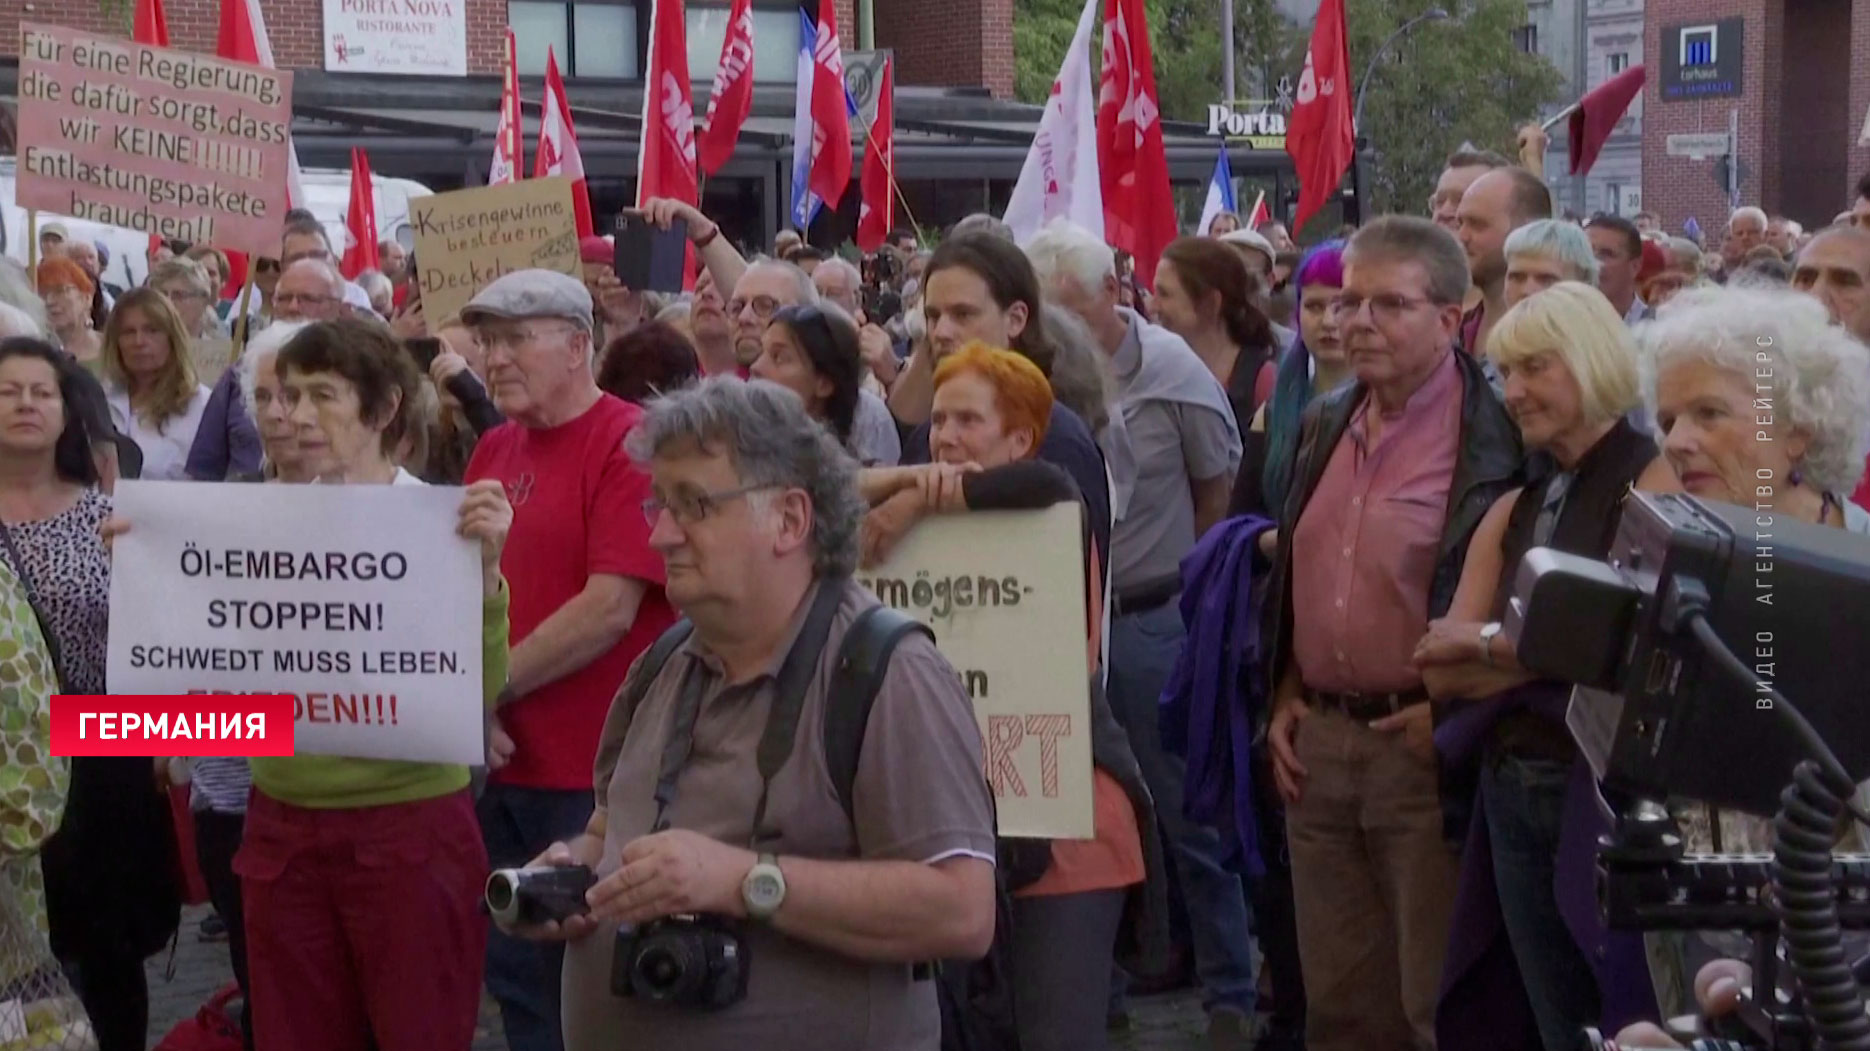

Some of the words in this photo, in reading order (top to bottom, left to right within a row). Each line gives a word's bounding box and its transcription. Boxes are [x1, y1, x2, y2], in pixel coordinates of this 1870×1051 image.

[356, 19, 436, 33] RISTORANTE
[22, 31, 63, 63] Für
[72, 41, 130, 74] eine
[139, 50, 281, 104] Regierung,
[22, 70, 61, 101] die
[71, 81, 142, 117] dafür
[60, 117, 100, 143] wir
[1206, 104, 1286, 135] Porta
[26, 146, 266, 218] Entlastungspakete
[71, 191, 214, 248] brauchen!!
[207, 600, 384, 631] STOPPEN!
[130, 645, 264, 672] SCHWEDT
[274, 650, 351, 674] MUSS
[362, 651, 466, 675] LEBEN.
